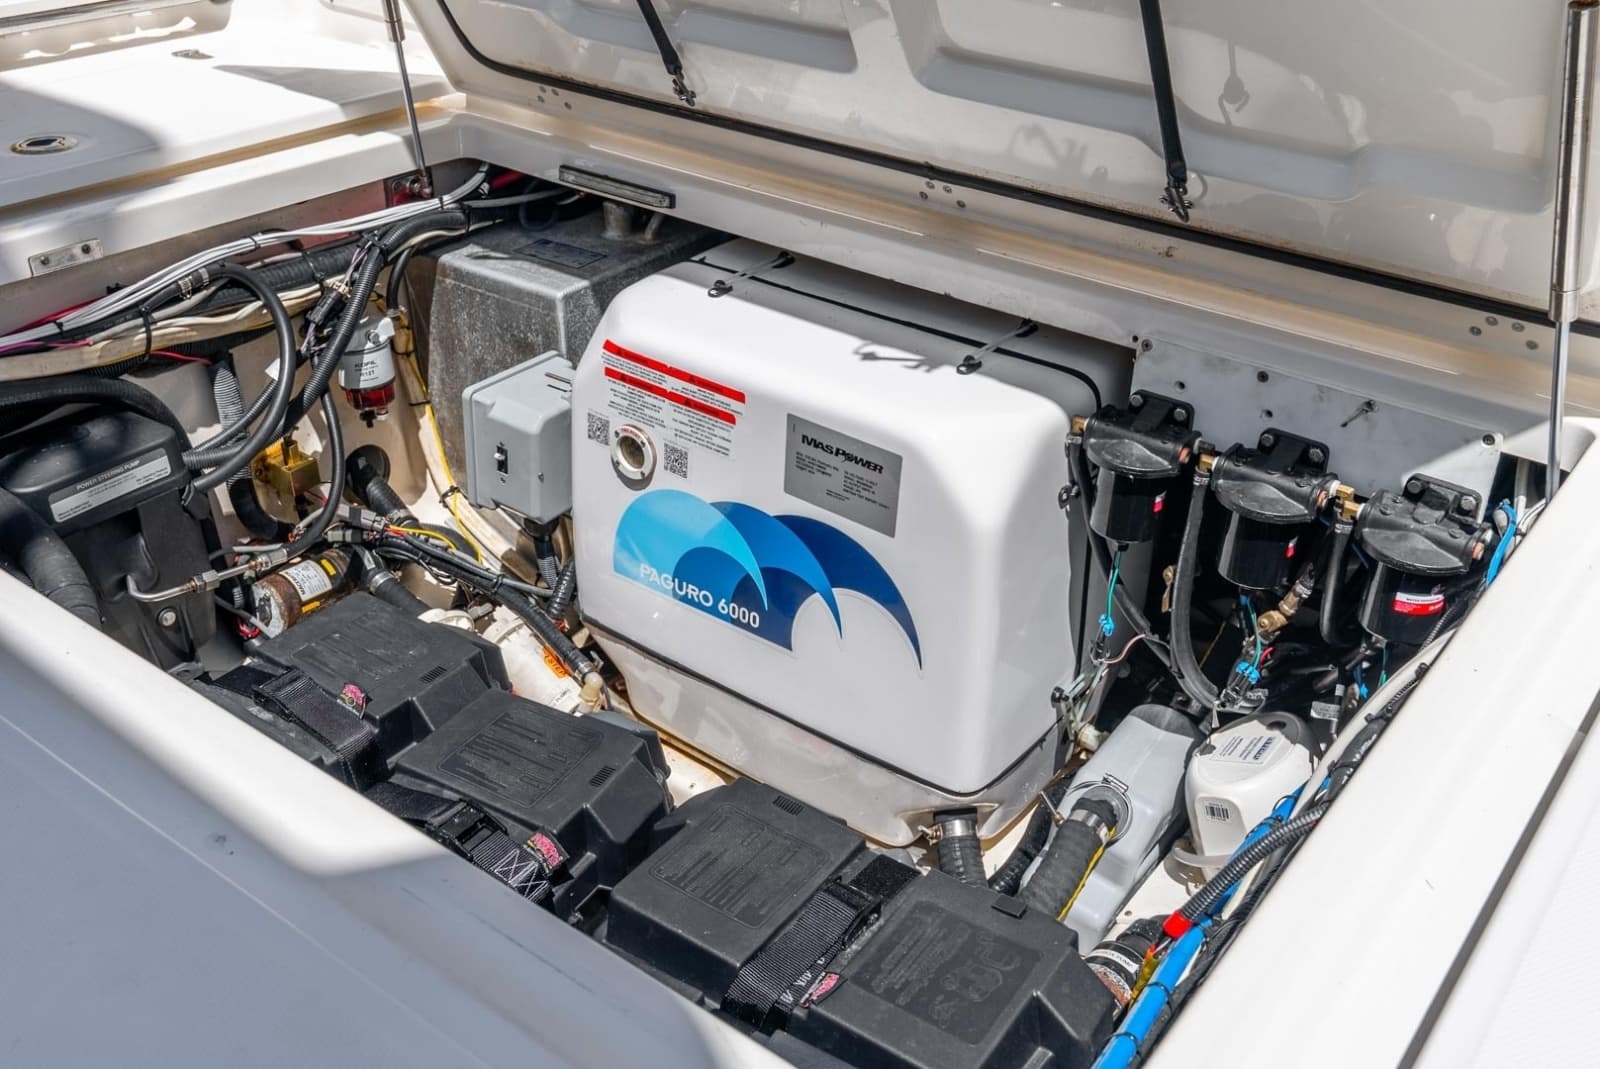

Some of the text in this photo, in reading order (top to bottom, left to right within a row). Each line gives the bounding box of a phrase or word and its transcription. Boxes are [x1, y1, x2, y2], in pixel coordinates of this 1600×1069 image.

[76, 478, 97, 491] POWER
[124, 459, 140, 470] PUMP
[640, 563, 760, 628] PAGURO 6000
